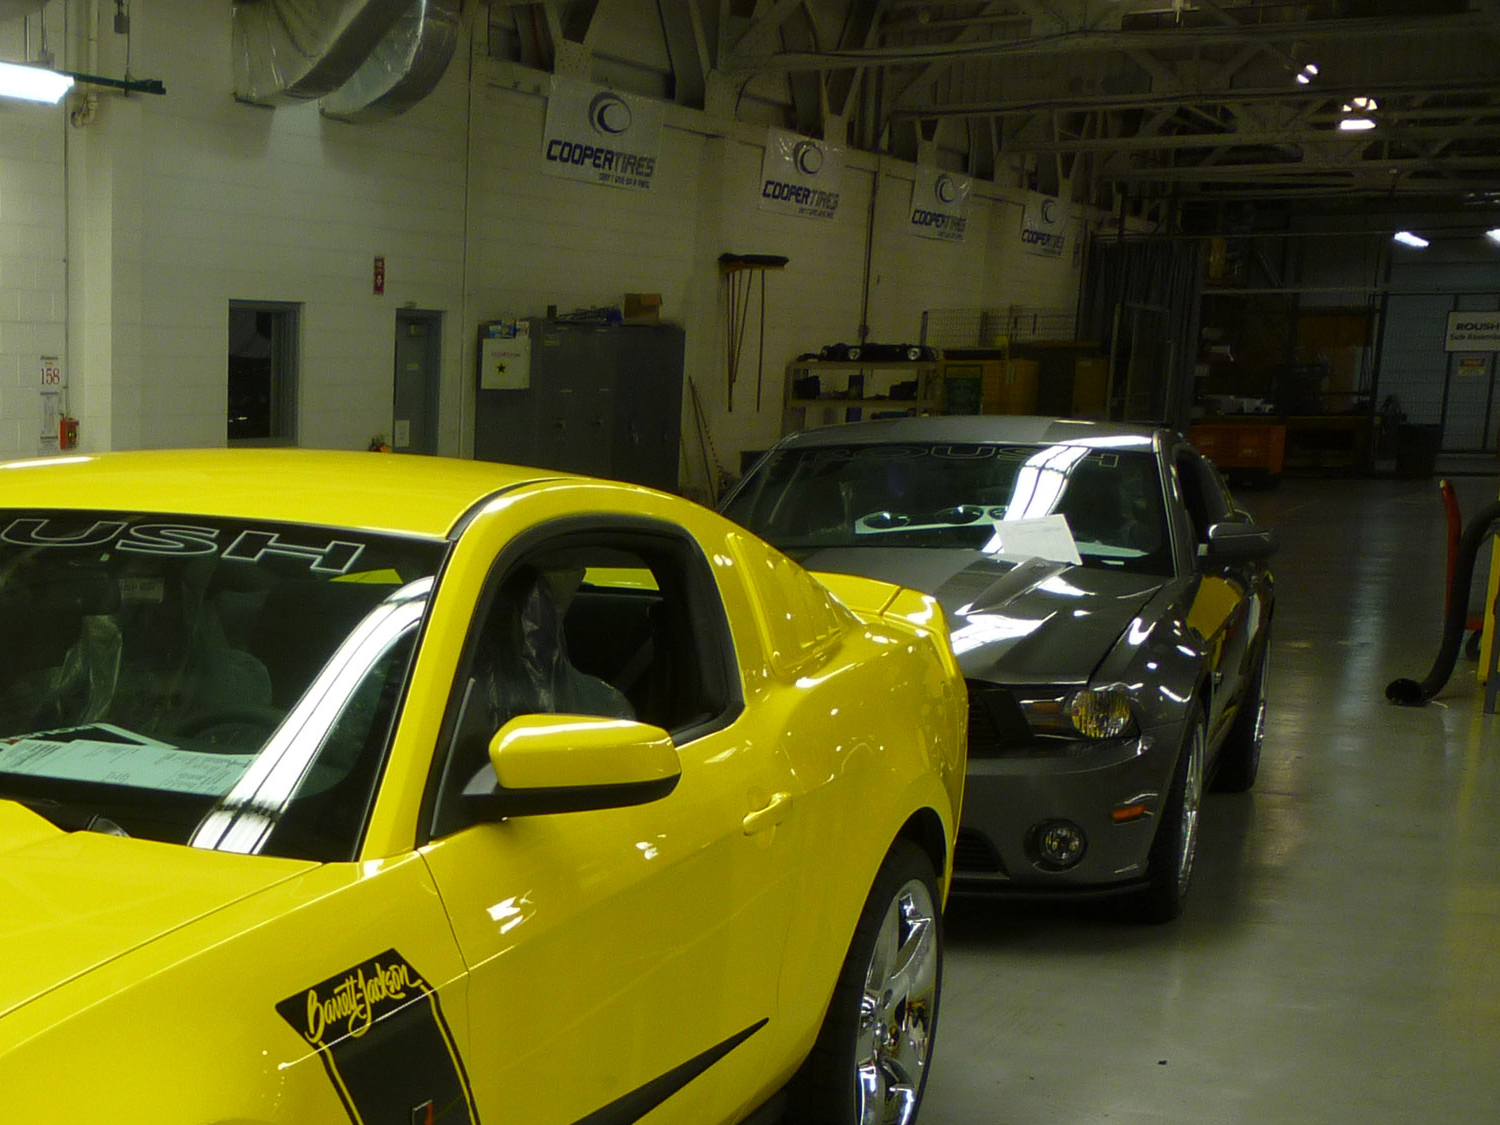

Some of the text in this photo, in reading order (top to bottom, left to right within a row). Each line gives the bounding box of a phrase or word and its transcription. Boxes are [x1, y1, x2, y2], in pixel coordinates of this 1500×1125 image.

[1456, 323, 1500, 331] ROUSH
[41, 367, 60, 385] 158
[304, 962, 423, 1043] Barrett-Jackson
